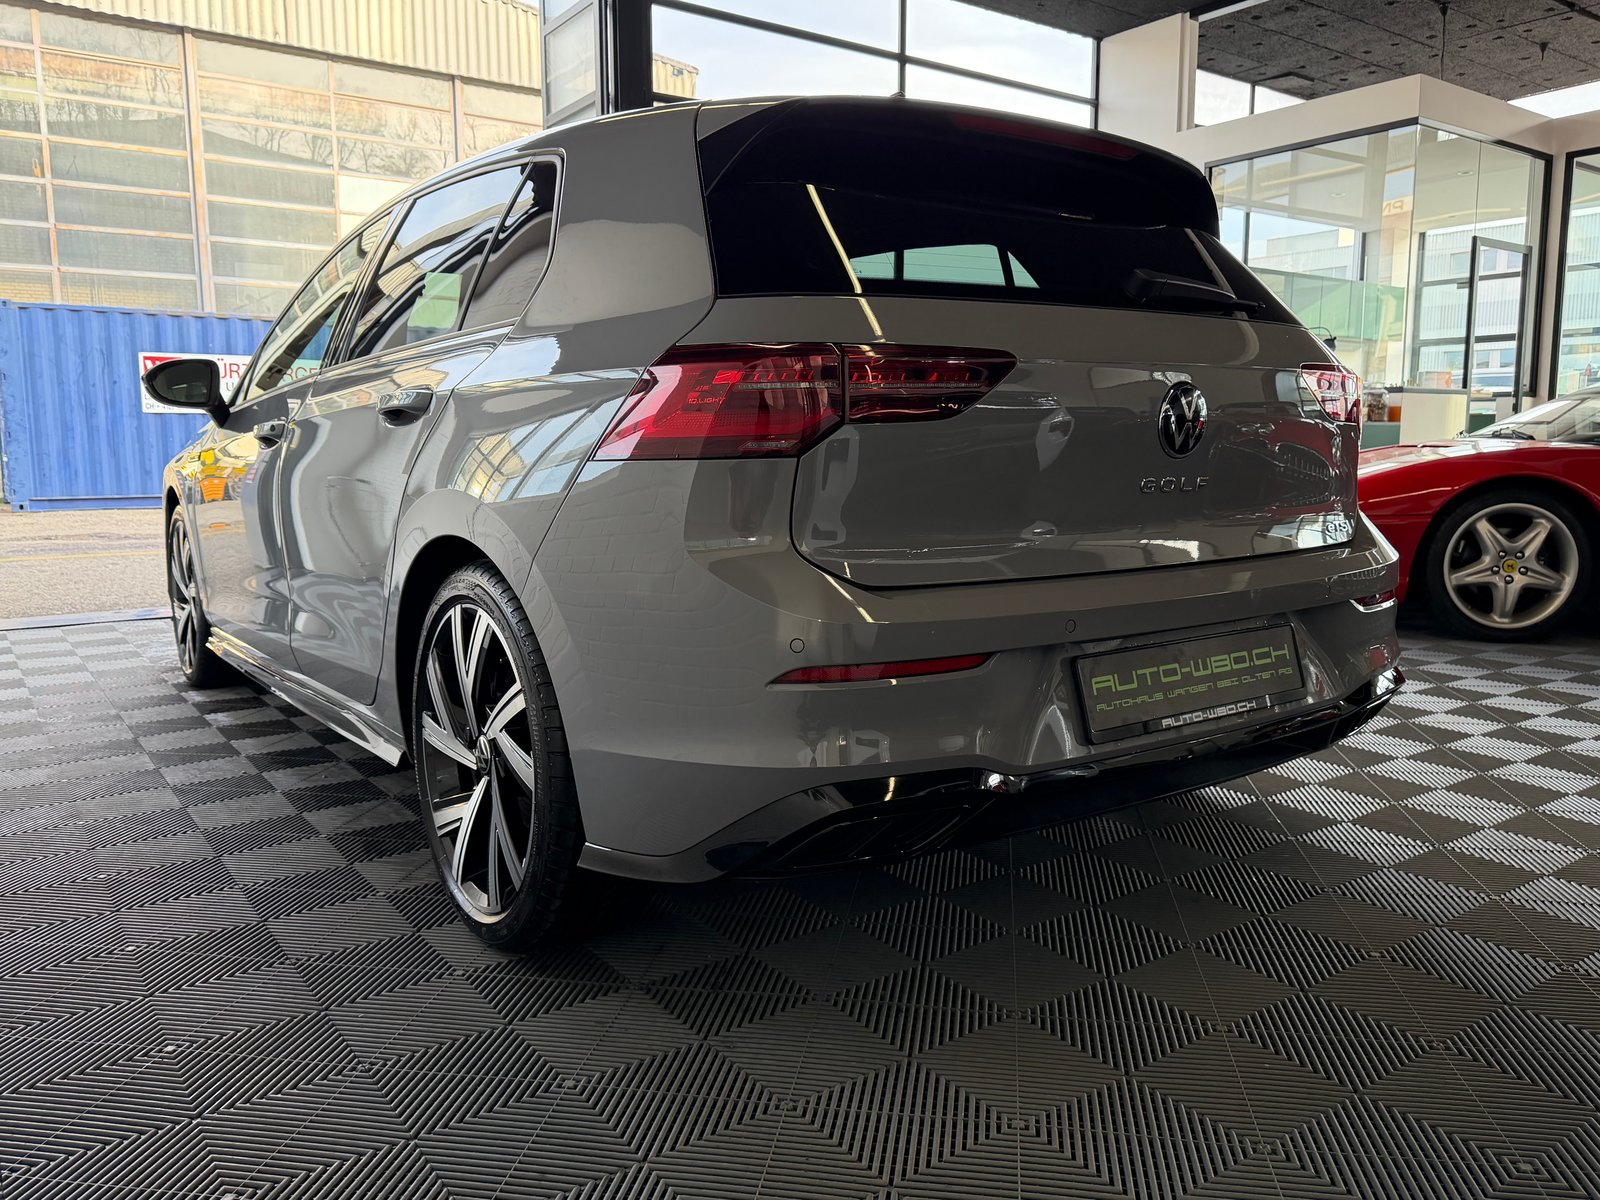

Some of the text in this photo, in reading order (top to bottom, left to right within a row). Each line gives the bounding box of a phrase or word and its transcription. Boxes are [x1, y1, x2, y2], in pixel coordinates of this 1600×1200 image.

[1140, 476, 1209, 494] GOLF
[1091, 643, 1291, 696] AUTO-WBO.CH
[1096, 692, 1164, 712] AUTOHAUS
[1167, 682, 1214, 699] WANGEN
[1242, 669, 1275, 684] OLTEN
